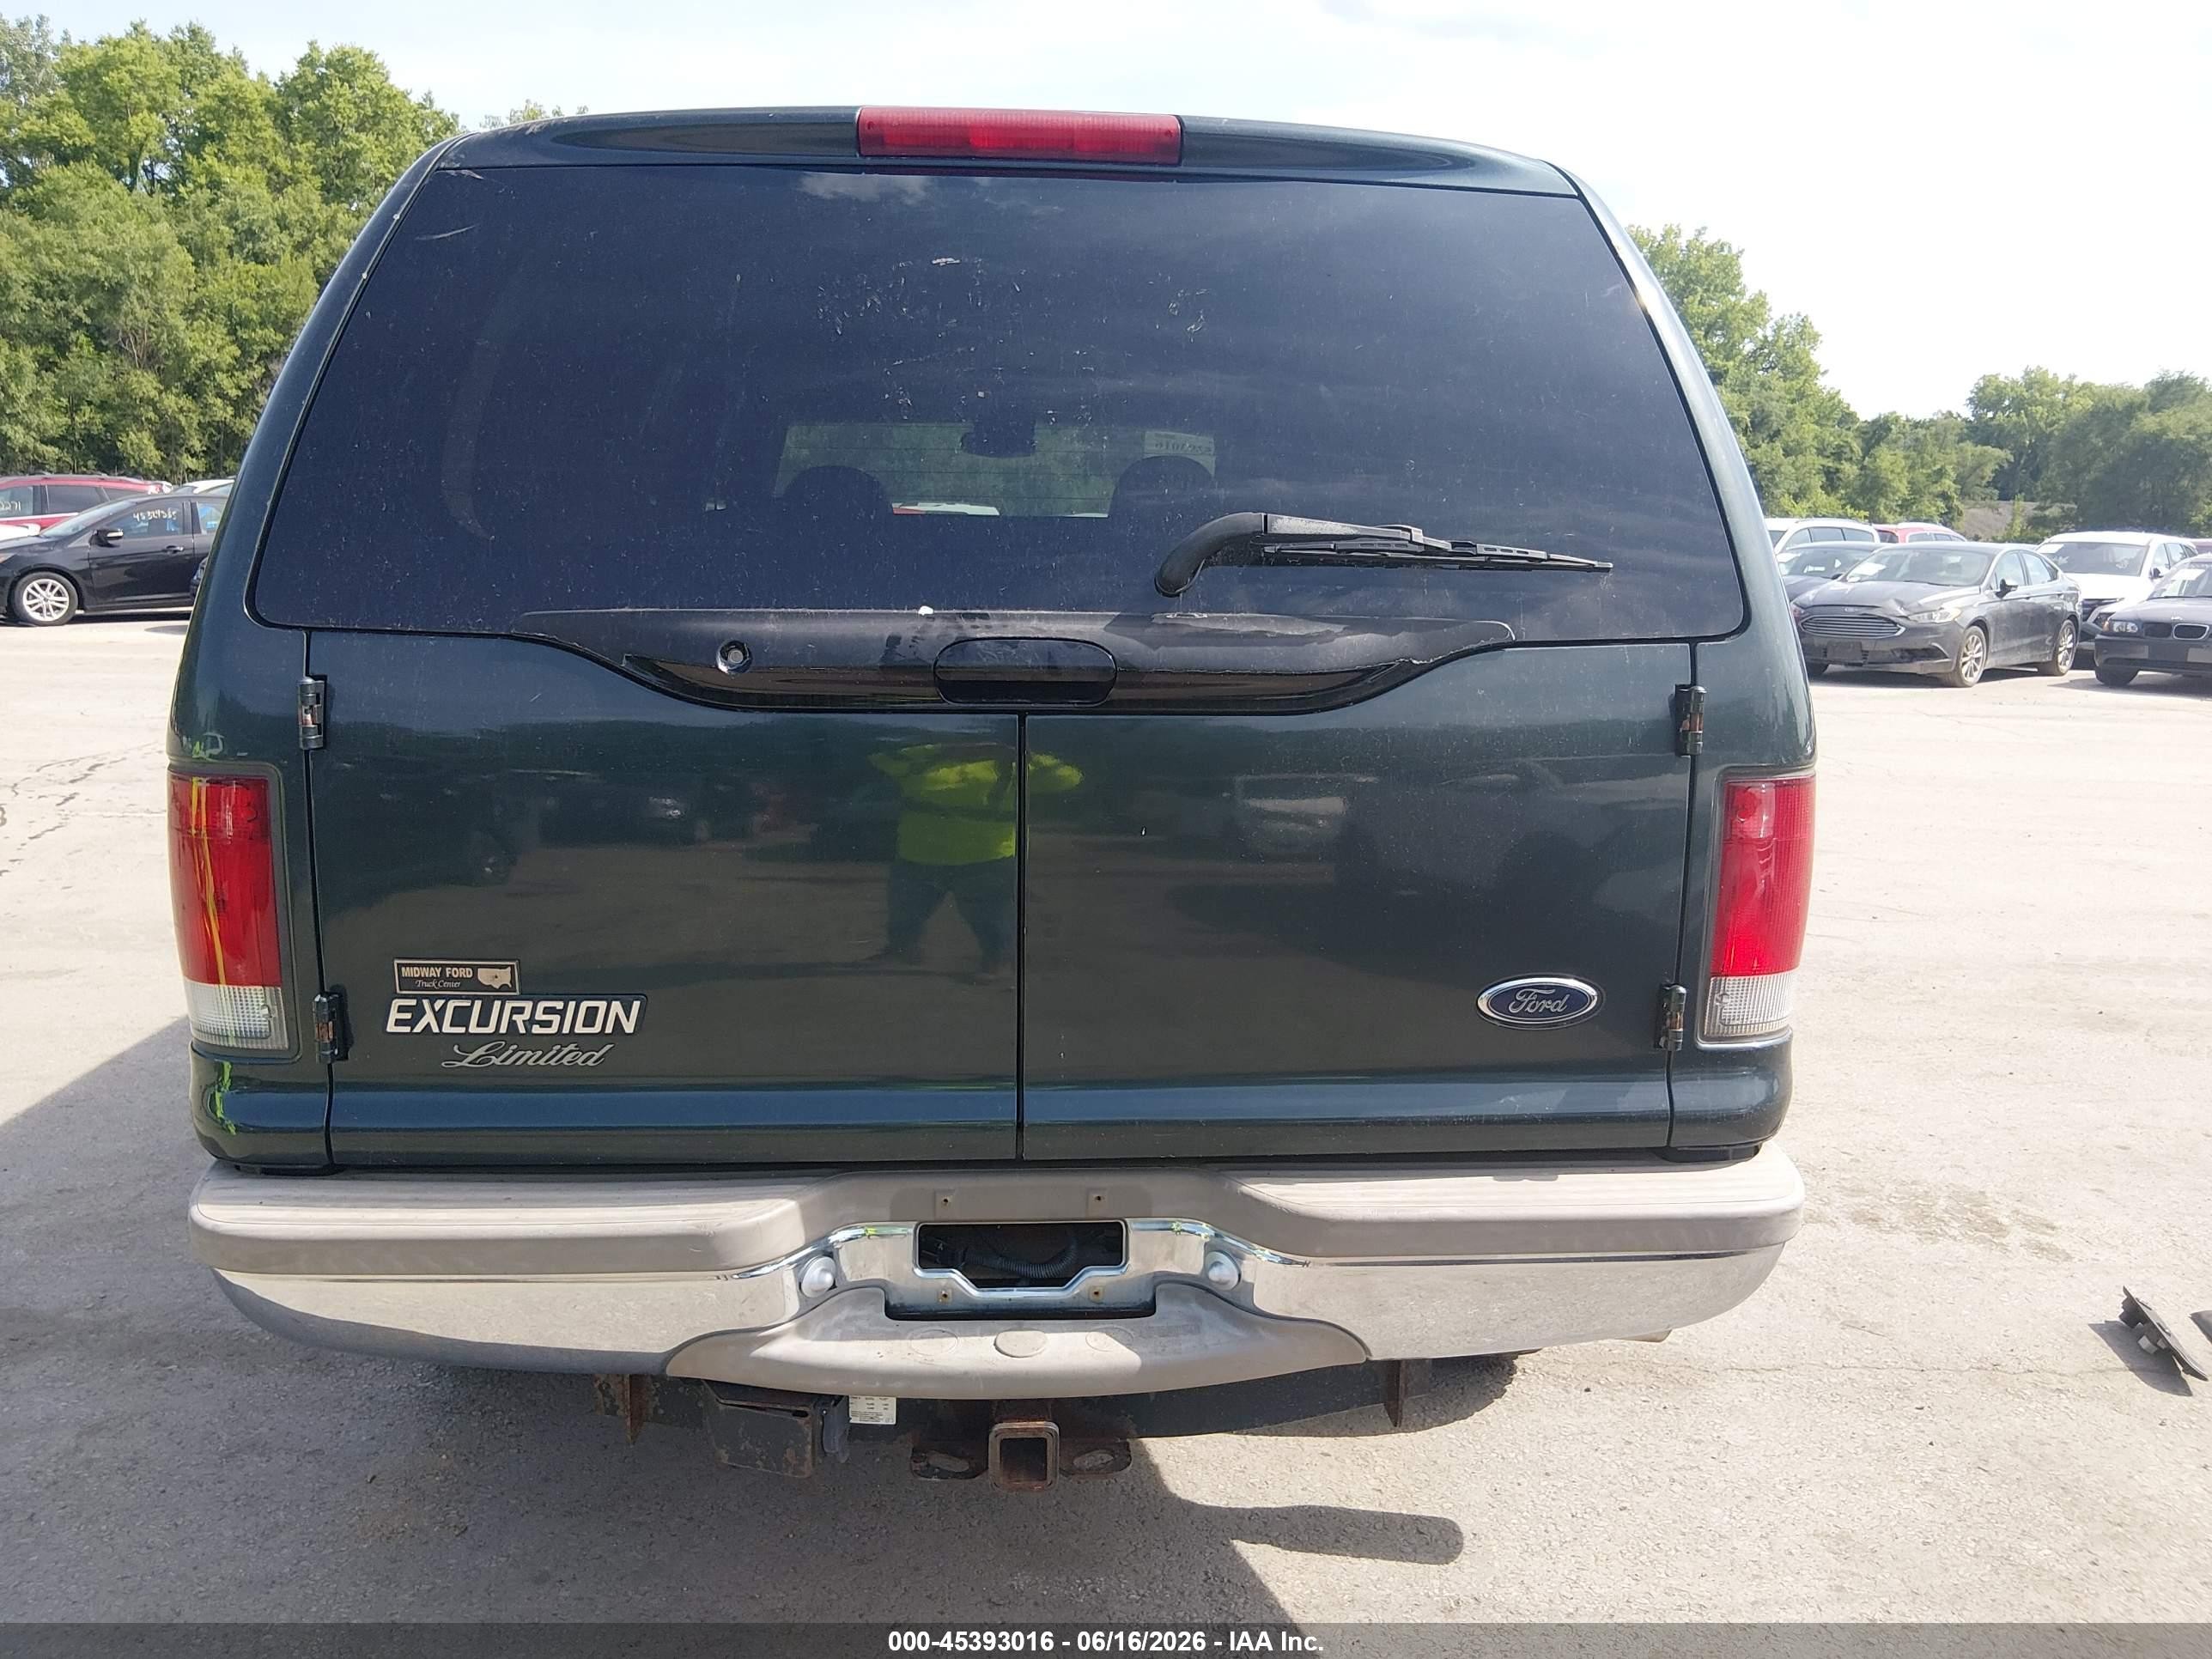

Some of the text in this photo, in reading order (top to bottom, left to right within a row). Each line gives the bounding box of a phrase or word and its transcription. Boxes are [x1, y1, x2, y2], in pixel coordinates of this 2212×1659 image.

[401, 966, 473, 978] MIDWAY FORD
[415, 979, 461, 988] Truck Center
[1508, 988, 1570, 1013] Ford
[386, 998, 641, 1034] EXCURSION
[441, 1041, 615, 1068] Limited
